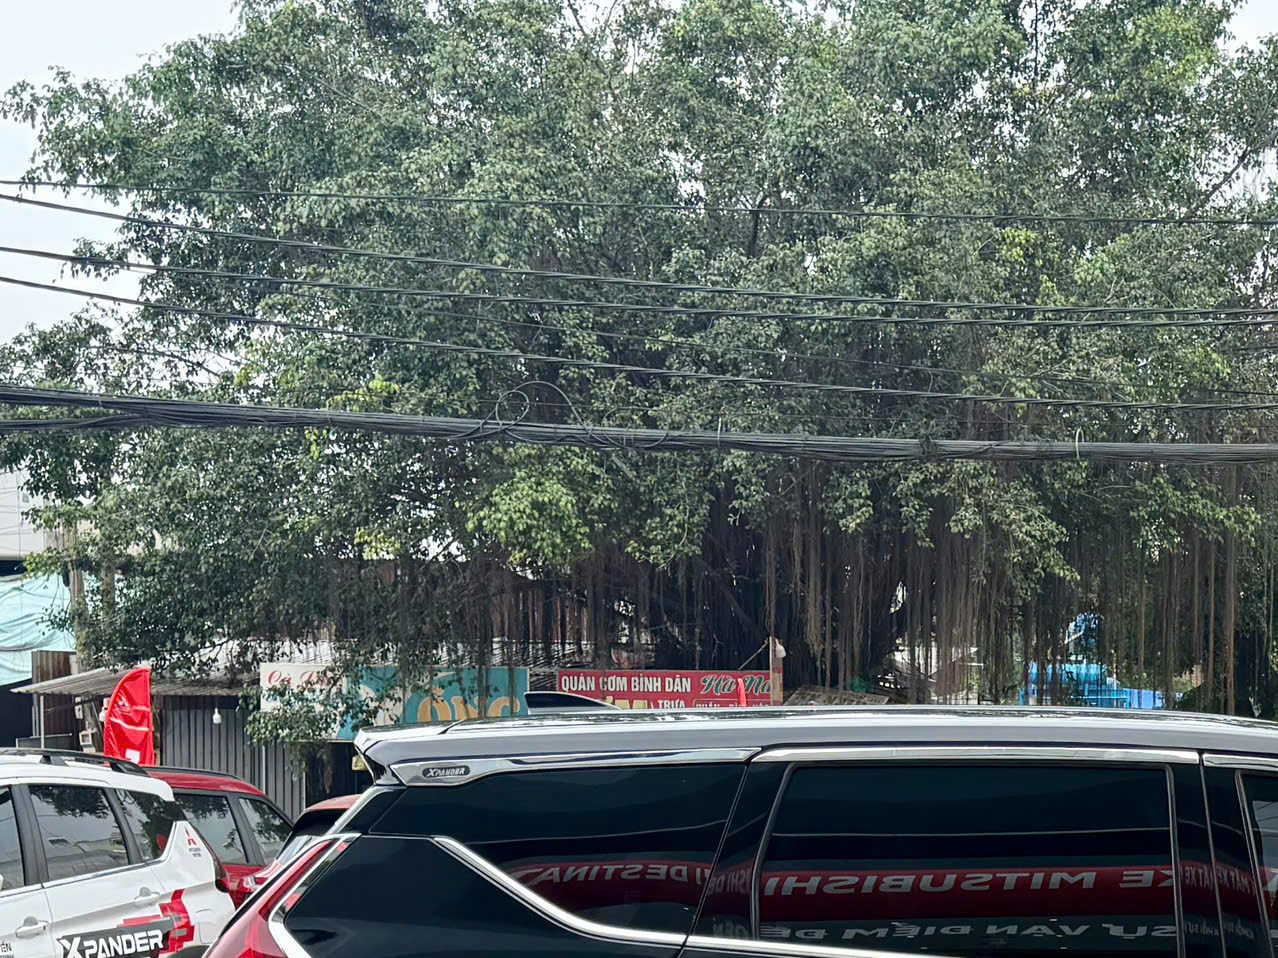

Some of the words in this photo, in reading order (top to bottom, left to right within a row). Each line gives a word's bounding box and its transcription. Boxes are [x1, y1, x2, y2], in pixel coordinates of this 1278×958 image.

[561, 673, 596, 692] QUÁN
[600, 675, 628, 692] CƠM
[631, 673, 662, 692] BÌNH
[667, 673, 691, 692] DÂN
[426, 767, 466, 777] XPANDER
